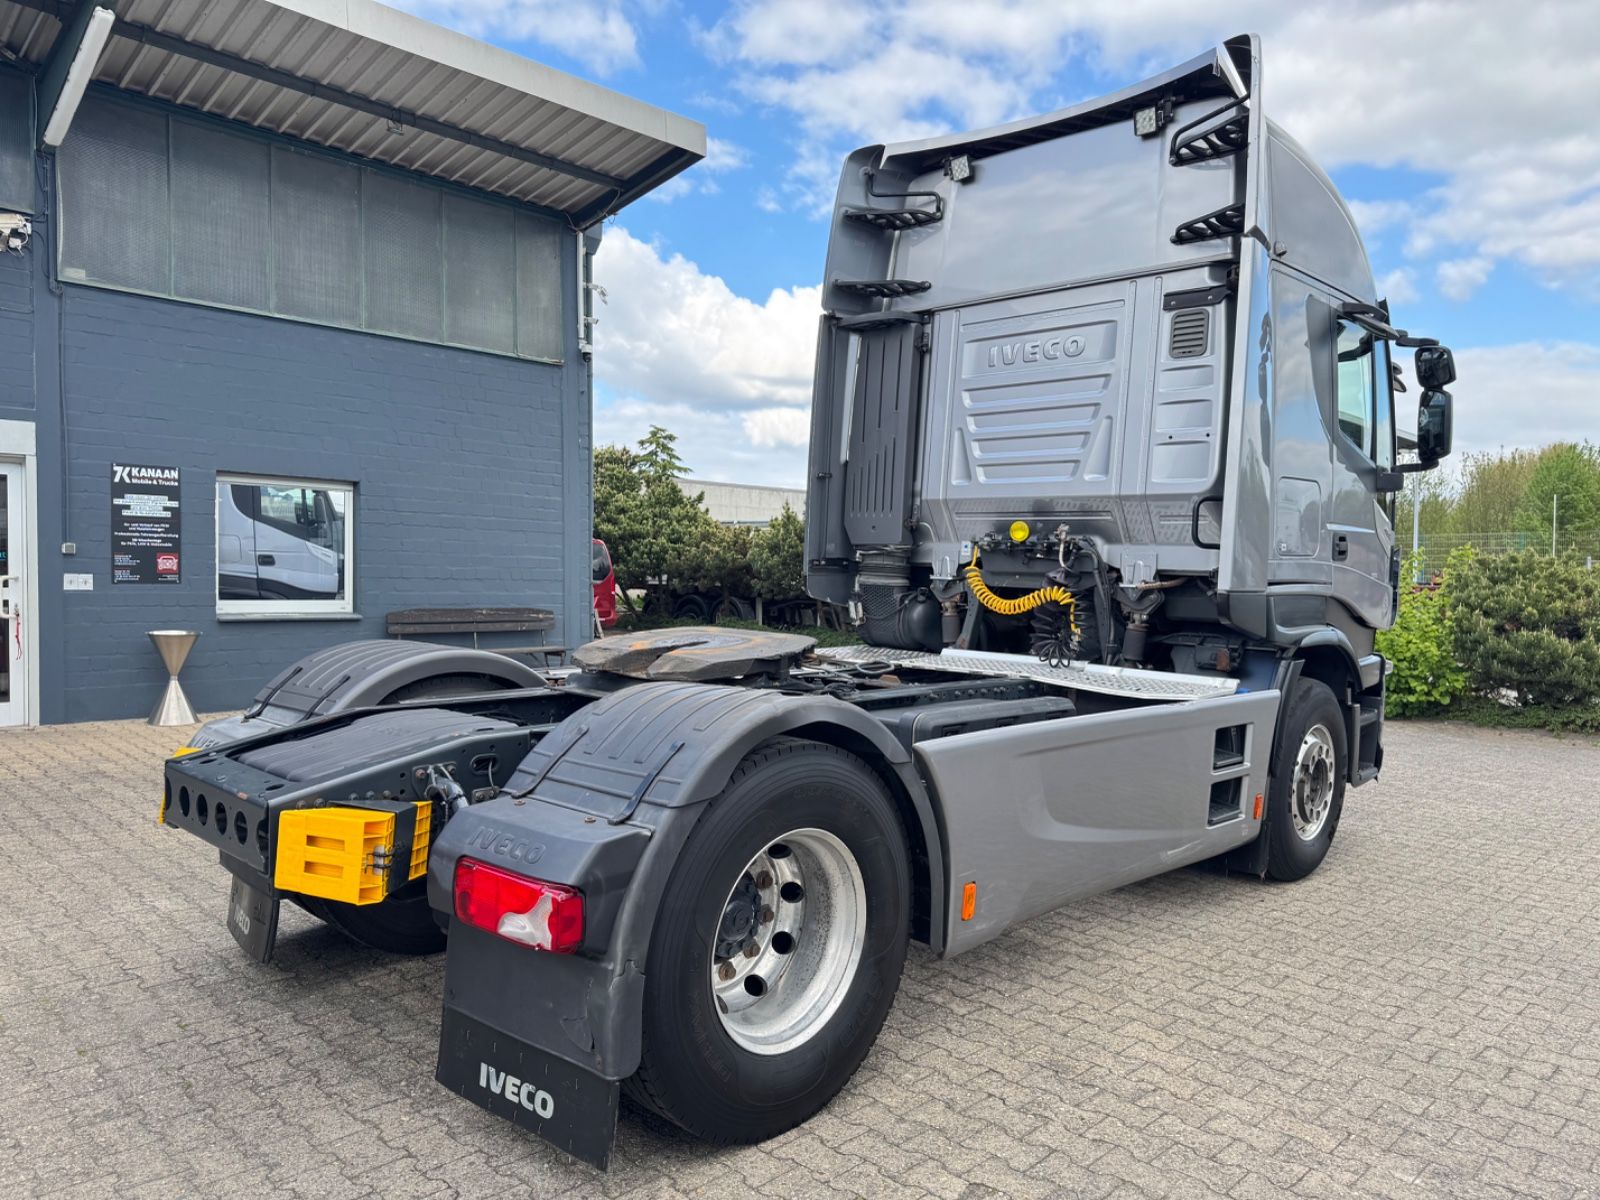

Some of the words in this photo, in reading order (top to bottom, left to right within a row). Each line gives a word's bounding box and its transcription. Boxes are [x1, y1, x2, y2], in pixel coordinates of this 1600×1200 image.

[987, 335, 1086, 368] IVECO
[131, 467, 179, 480] KANAAN
[468, 826, 547, 865] IVECO
[479, 1062, 555, 1119] IVECO
